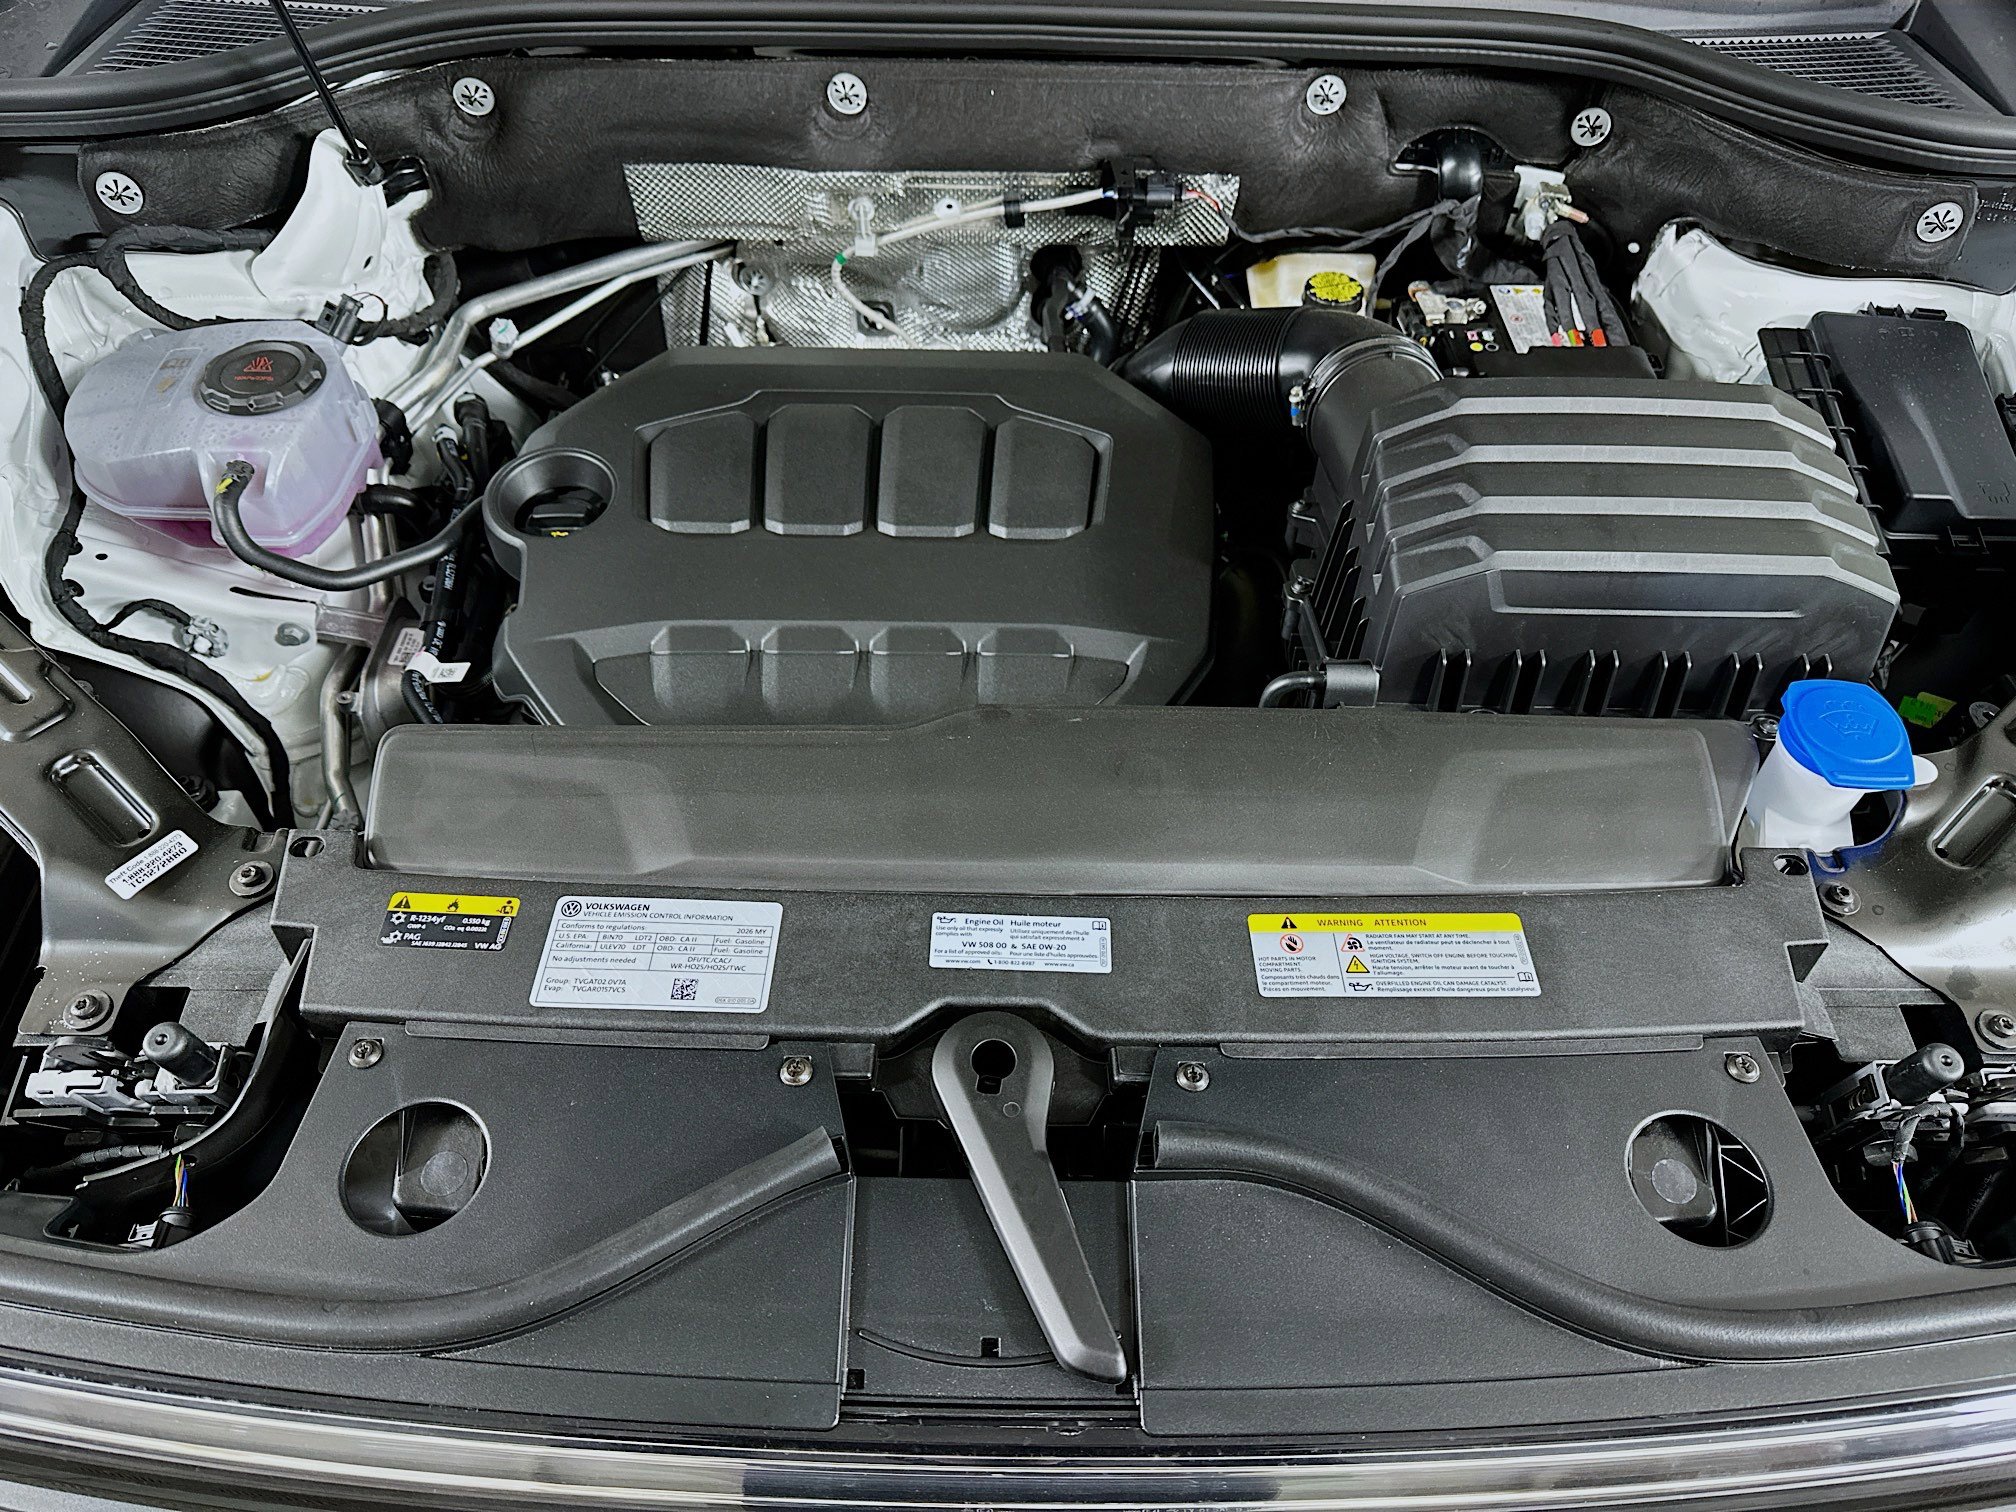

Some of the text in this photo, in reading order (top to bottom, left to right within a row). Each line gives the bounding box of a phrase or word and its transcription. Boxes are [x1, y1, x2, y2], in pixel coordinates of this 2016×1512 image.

[109, 870, 127, 884] Theft
[127, 859, 145, 872] Code
[585, 902, 651, 911] VOLKSWAGEN
[410, 914, 447, 925] R-1234yf
[613, 911, 648, 919] EMISSION
[649, 912, 681, 920] CONTROL
[481, 918, 491, 927] kg
[561, 922, 595, 930] Conforms
[965, 918, 991, 926] Engine
[1317, 919, 1427, 927] WARNING ATTENTION
[402, 933, 422, 941] PAG
[474, 942, 502, 951] VW AG
[563, 955, 608, 964] adjustments
